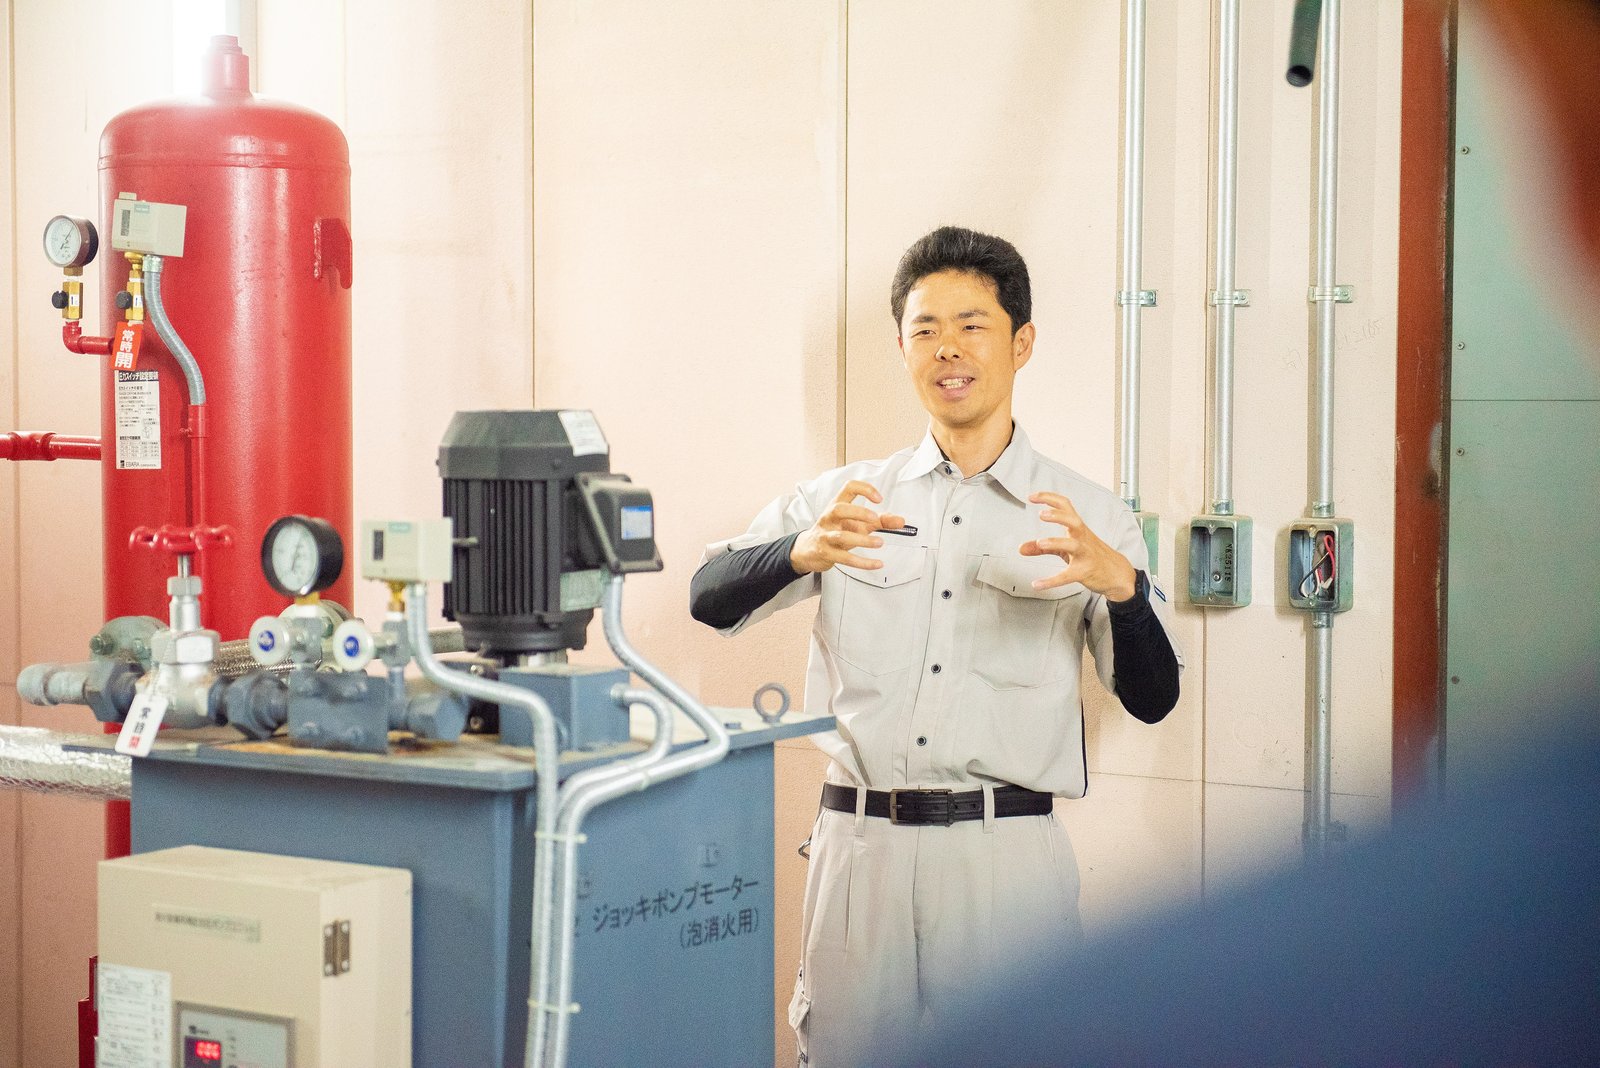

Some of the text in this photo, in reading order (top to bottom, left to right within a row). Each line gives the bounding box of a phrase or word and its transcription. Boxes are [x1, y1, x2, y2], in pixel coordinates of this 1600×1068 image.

[115, 329, 135, 369] 常時開
[593, 875, 759, 933] ジョッキポンプモーター
